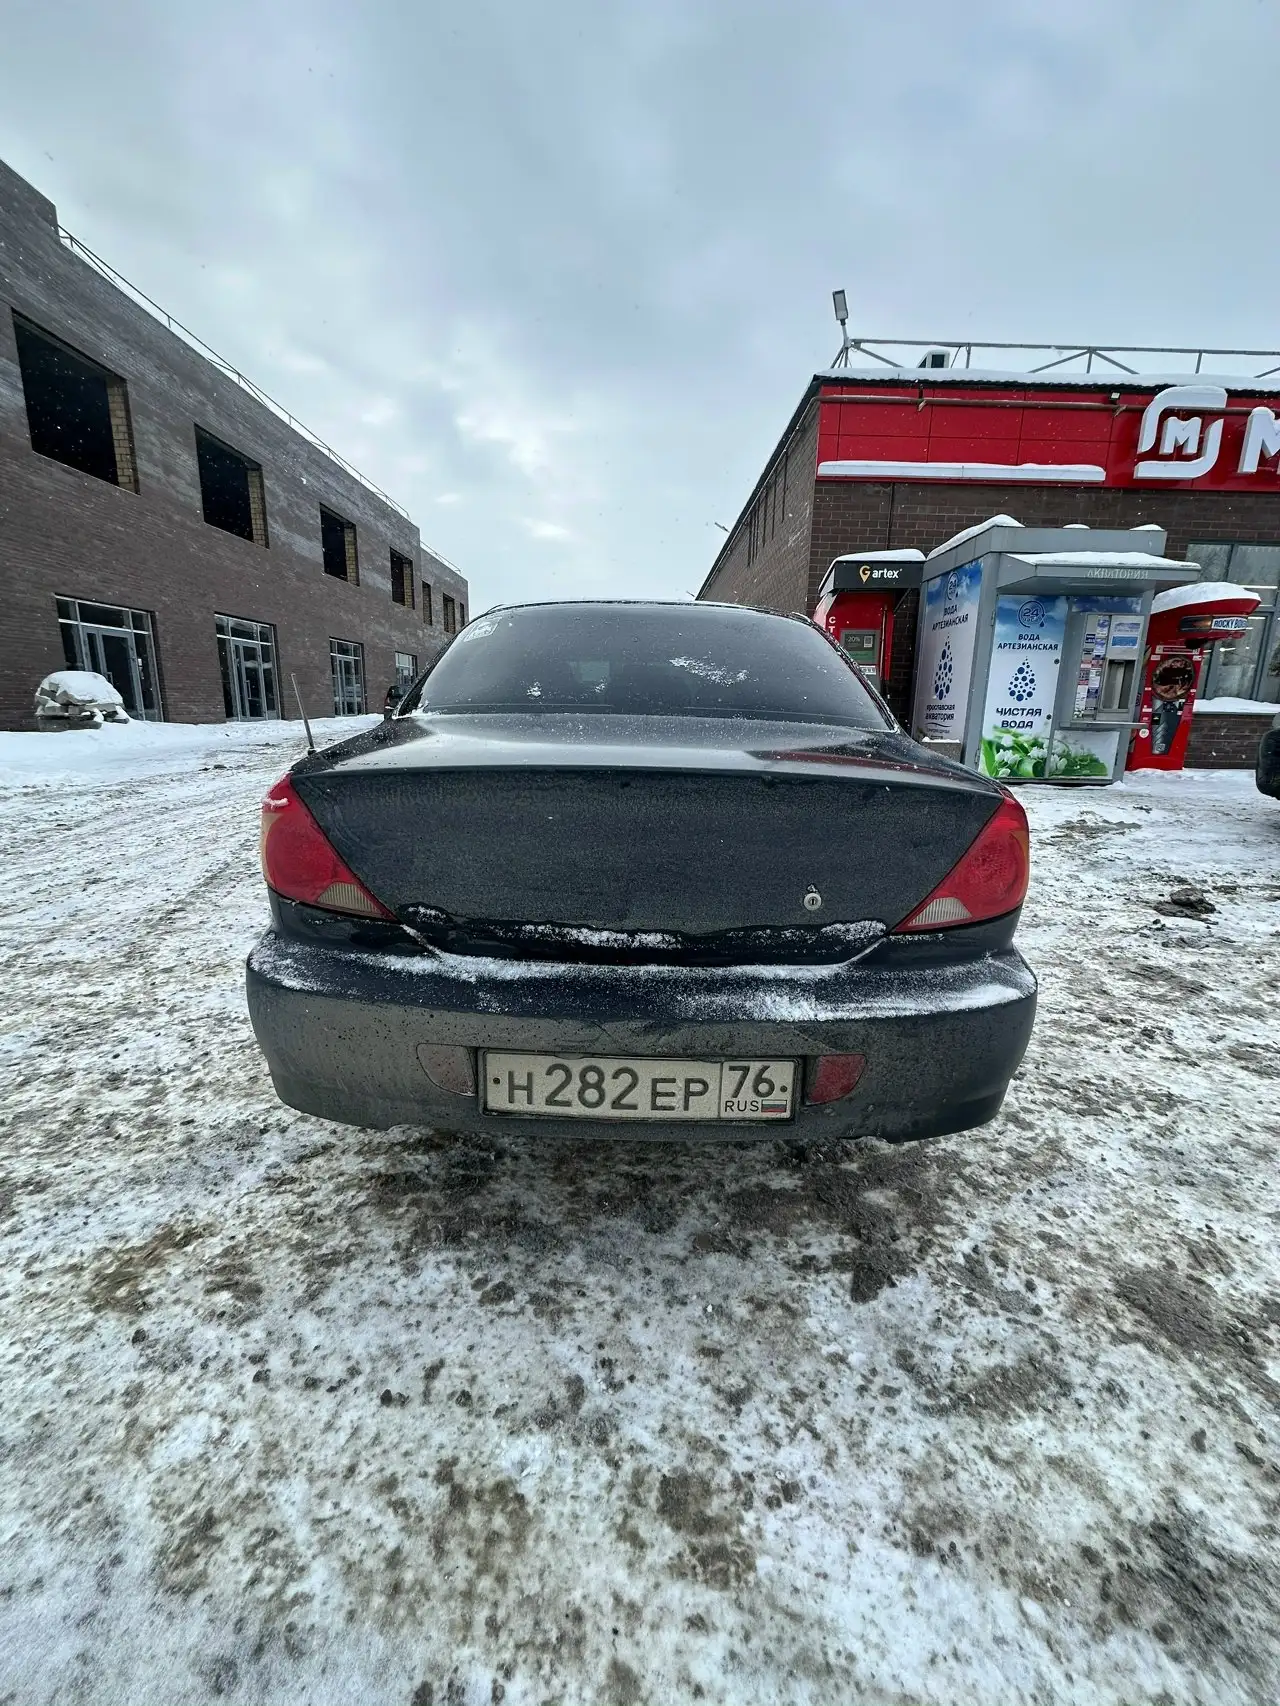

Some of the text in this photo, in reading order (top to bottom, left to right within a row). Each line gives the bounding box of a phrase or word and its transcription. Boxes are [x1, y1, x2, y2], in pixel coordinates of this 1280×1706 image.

[1087, 568, 1149, 579] АКВАТОРИЯ
[943, 604, 958, 617] ВОДА
[1023, 608, 1039, 617] 24
[932, 613, 969, 631] АРТЕЗИАНСКАЯ
[1018, 633, 1040, 641] ВОДА
[997, 642, 1059, 651] АРТЕЗИАНСКАЯ
[996, 707, 1042, 717] ЧИСТАЯ
[1001, 719, 1034, 729] ВОДА
[728, 1065, 775, 1098] 76
[724, 1100, 759, 1112] RUS
